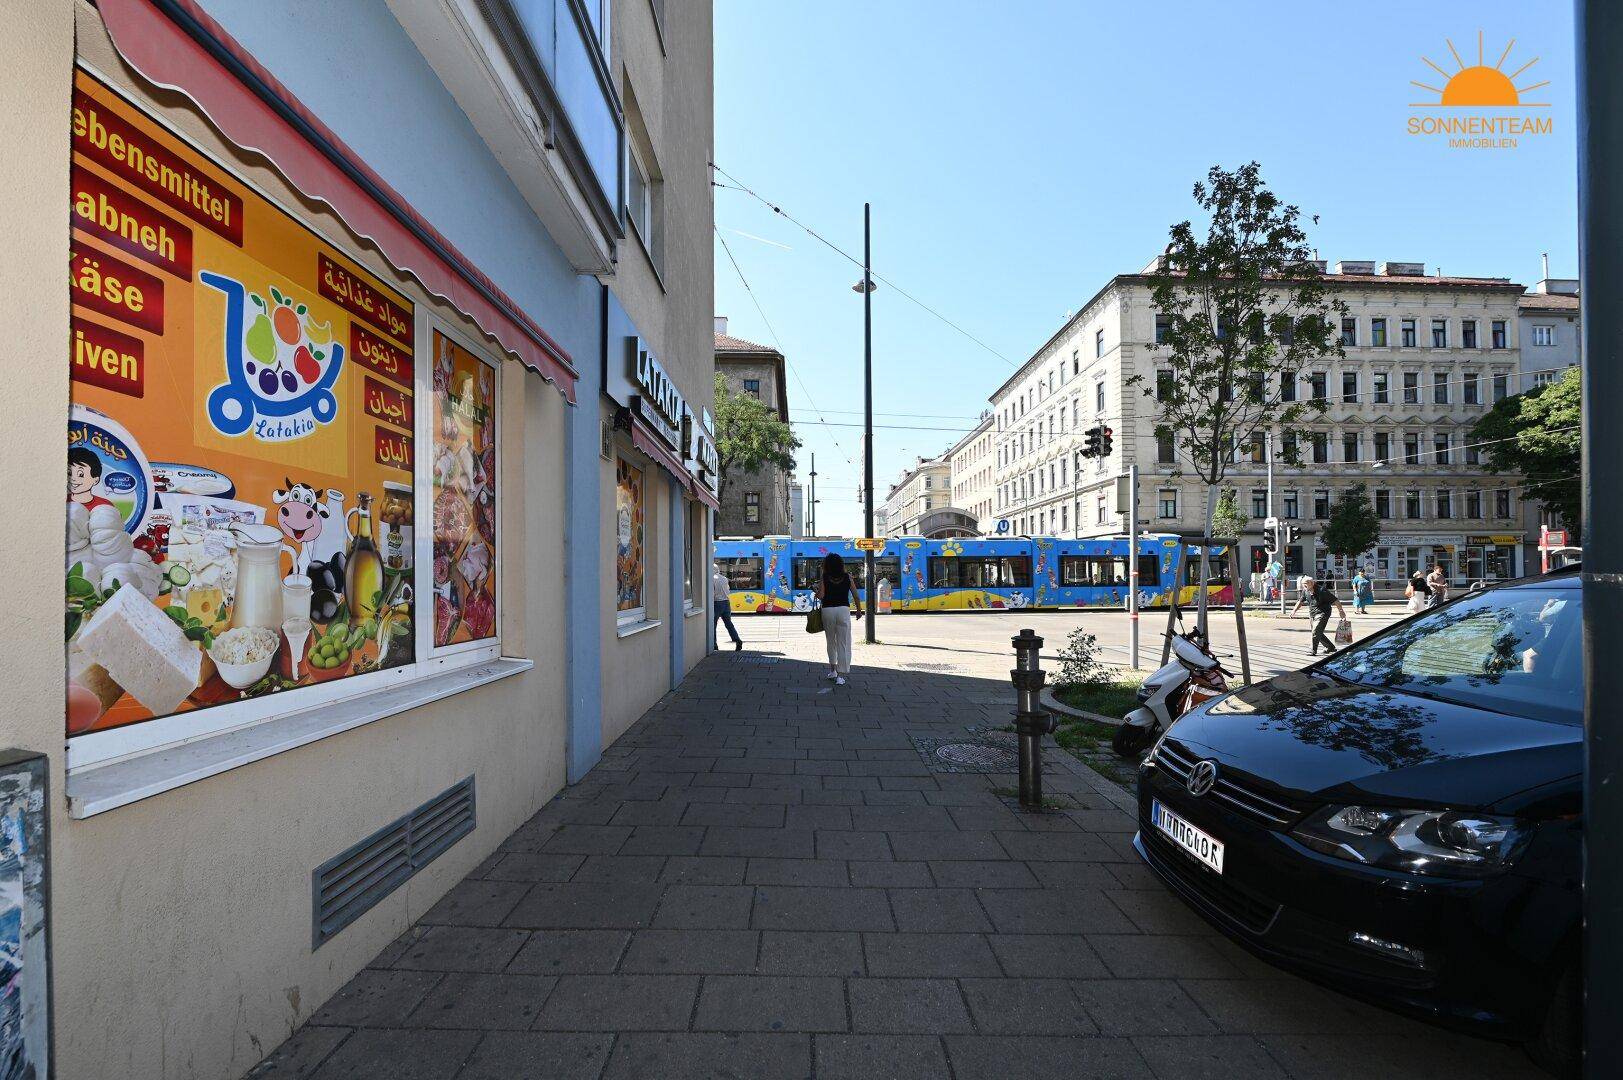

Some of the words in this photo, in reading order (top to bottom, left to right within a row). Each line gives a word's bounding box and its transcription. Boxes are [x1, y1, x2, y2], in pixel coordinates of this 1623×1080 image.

[73, 191, 176, 262] abneh
[325, 261, 374, 313] غذائية
[379, 303, 407, 335] مواد
[71, 331, 138, 381] iven
[359, 332, 398, 374] زيتون
[370, 390, 407, 424] أجبان
[452, 396, 482, 423] HALAL
[255, 419, 314, 438] Latakia
[380, 437, 409, 469] ألبان
[178, 471, 218, 479] Creamy
